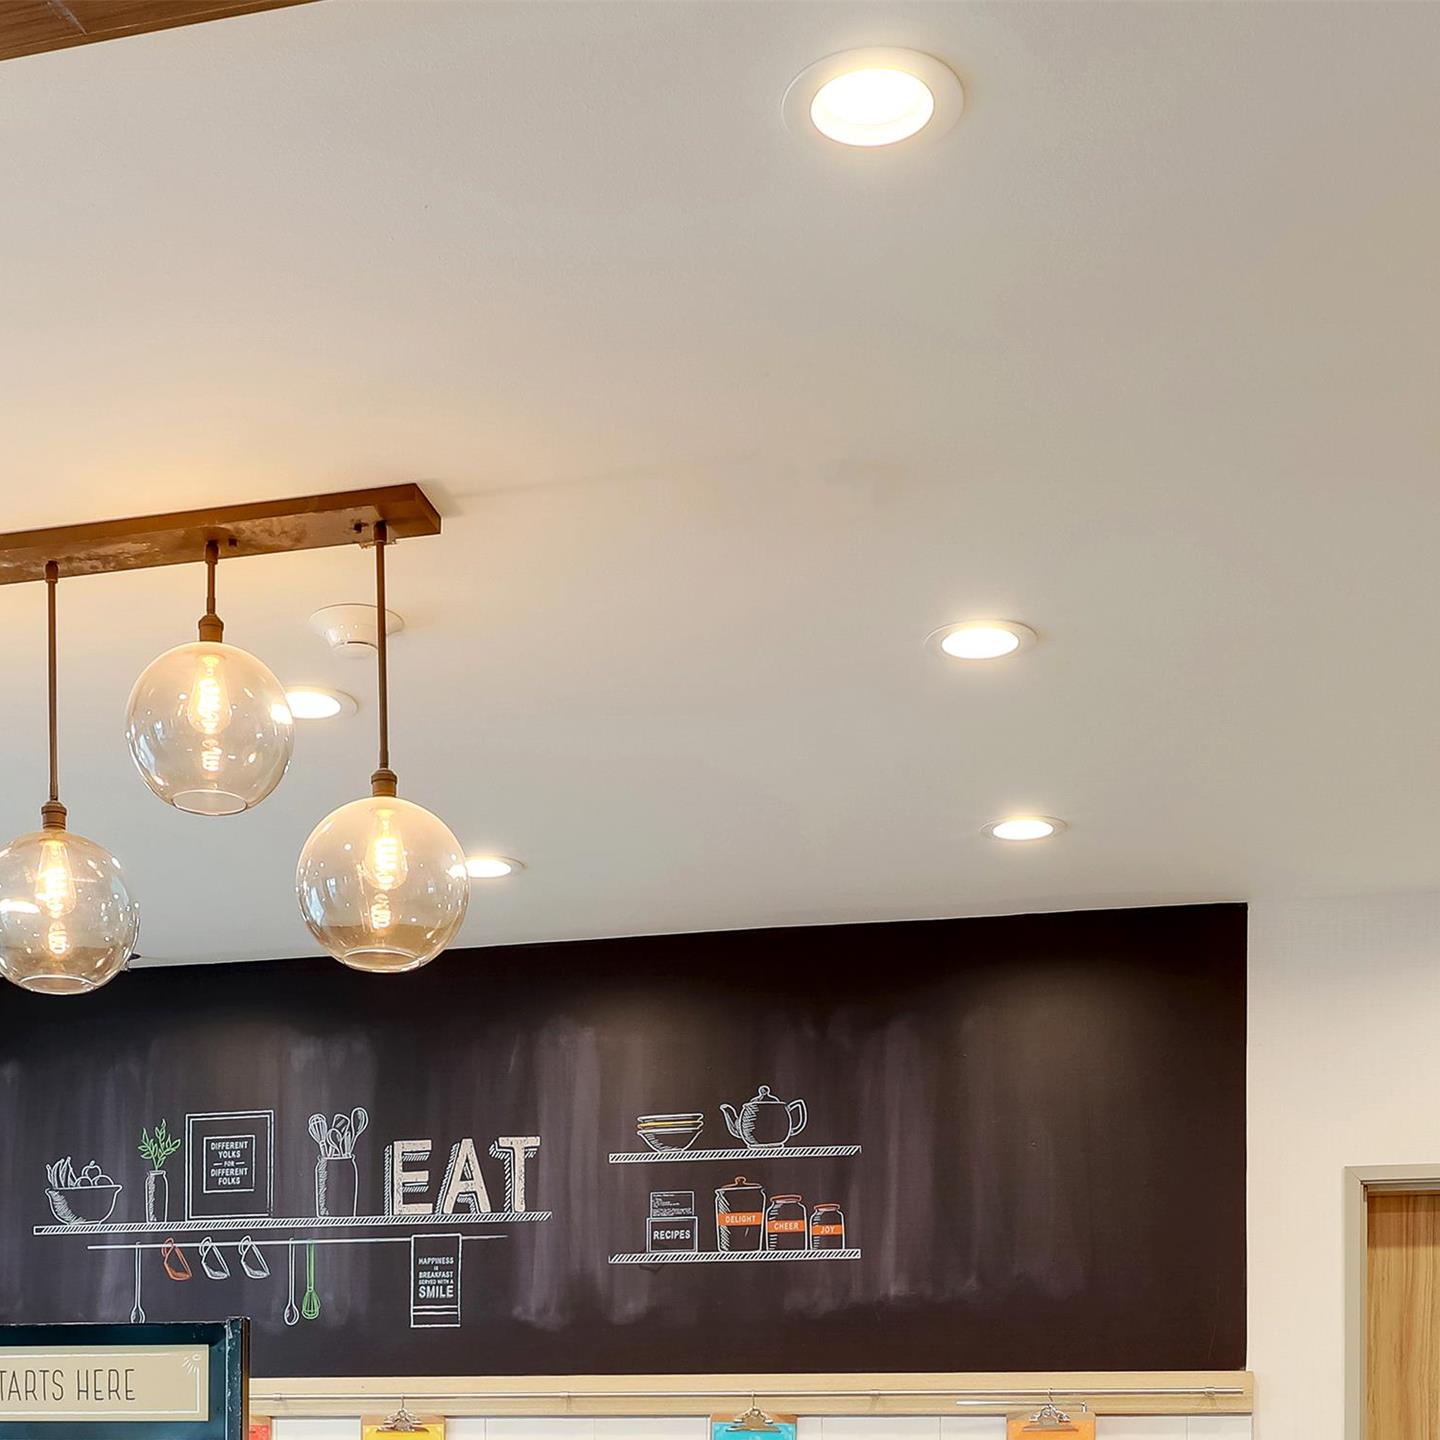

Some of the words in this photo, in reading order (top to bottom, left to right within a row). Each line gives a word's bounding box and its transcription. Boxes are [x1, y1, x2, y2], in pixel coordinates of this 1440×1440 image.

[210, 1141, 248, 1150] DIFFERENT
[218, 1150, 241, 1159] YOLKS
[210, 1168, 248, 1177] DIFFERENT
[385, 1136, 541, 1217] EAT
[218, 1177, 241, 1186] FOLKS
[725, 1215, 756, 1224] DELIGHT
[773, 1222, 799, 1231] CHEER
[820, 1226, 835, 1234] JOY
[653, 1230, 691, 1240] RECIPES
[418, 1271, 454, 1279] BREAKFAST
[418, 1285, 454, 1298] SMILE
[76, 1368, 136, 1401] HERE
